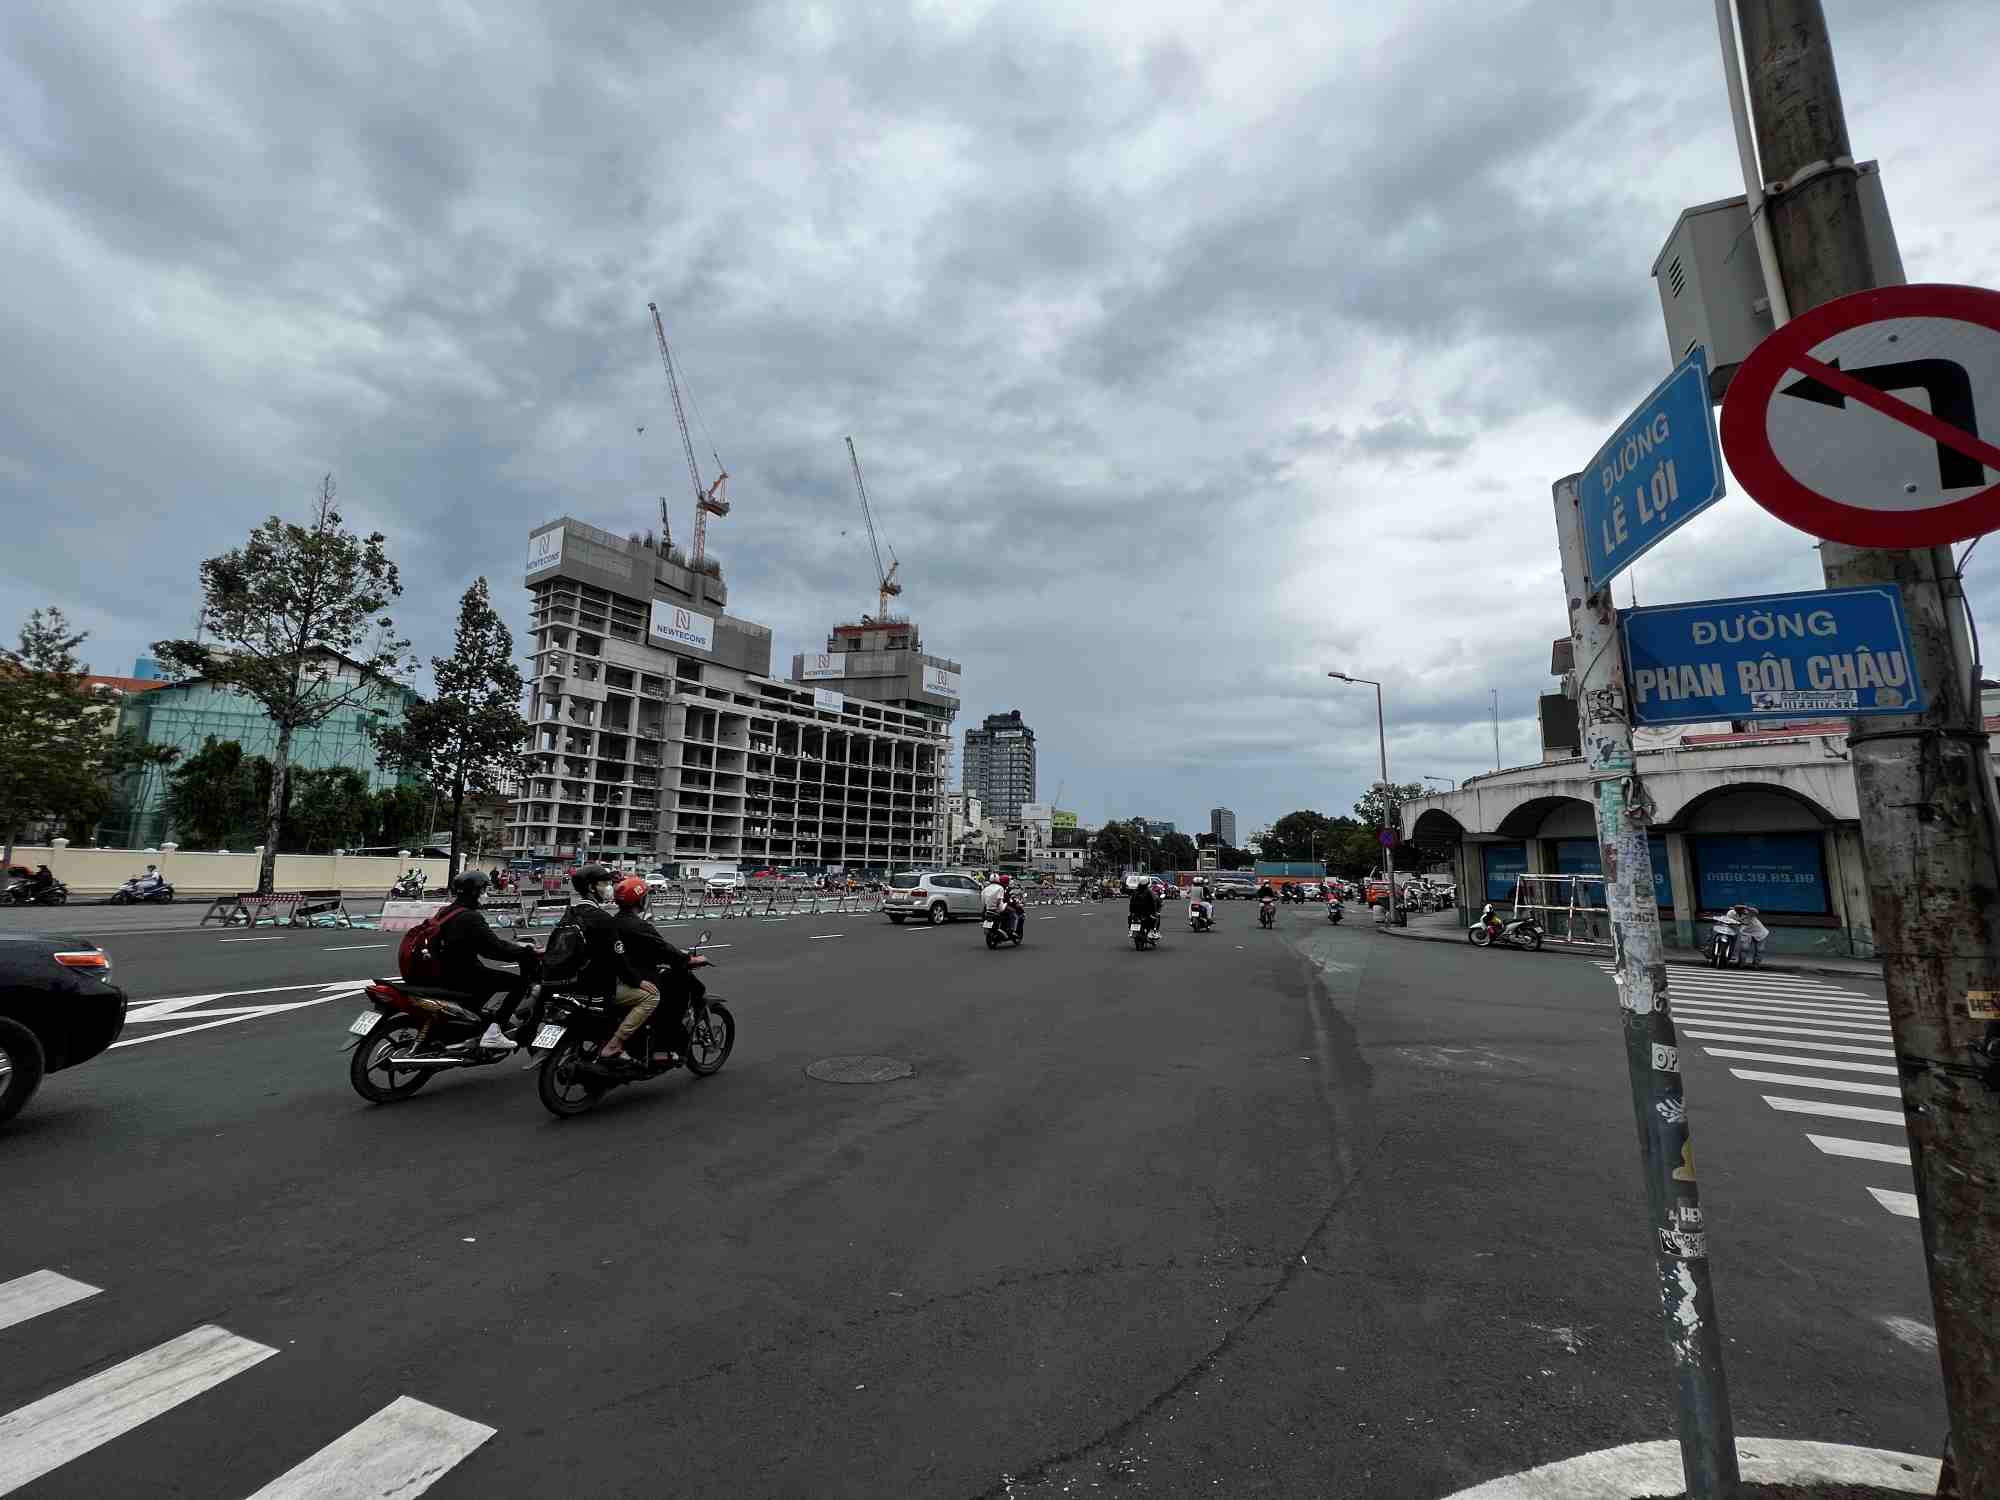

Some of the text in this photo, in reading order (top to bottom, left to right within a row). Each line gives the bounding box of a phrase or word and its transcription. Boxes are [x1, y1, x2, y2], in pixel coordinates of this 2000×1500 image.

[1602, 411, 1669, 496] ĐƯỜNG
[1602, 459, 1679, 556] LÊ LỢI
[657, 624, 707, 645] NEWTECONS
[1692, 610, 1838, 645] ĐƯỜNG
[1634, 662, 1728, 703] PHAN
[1807, 645, 1906, 690] CHÂU
